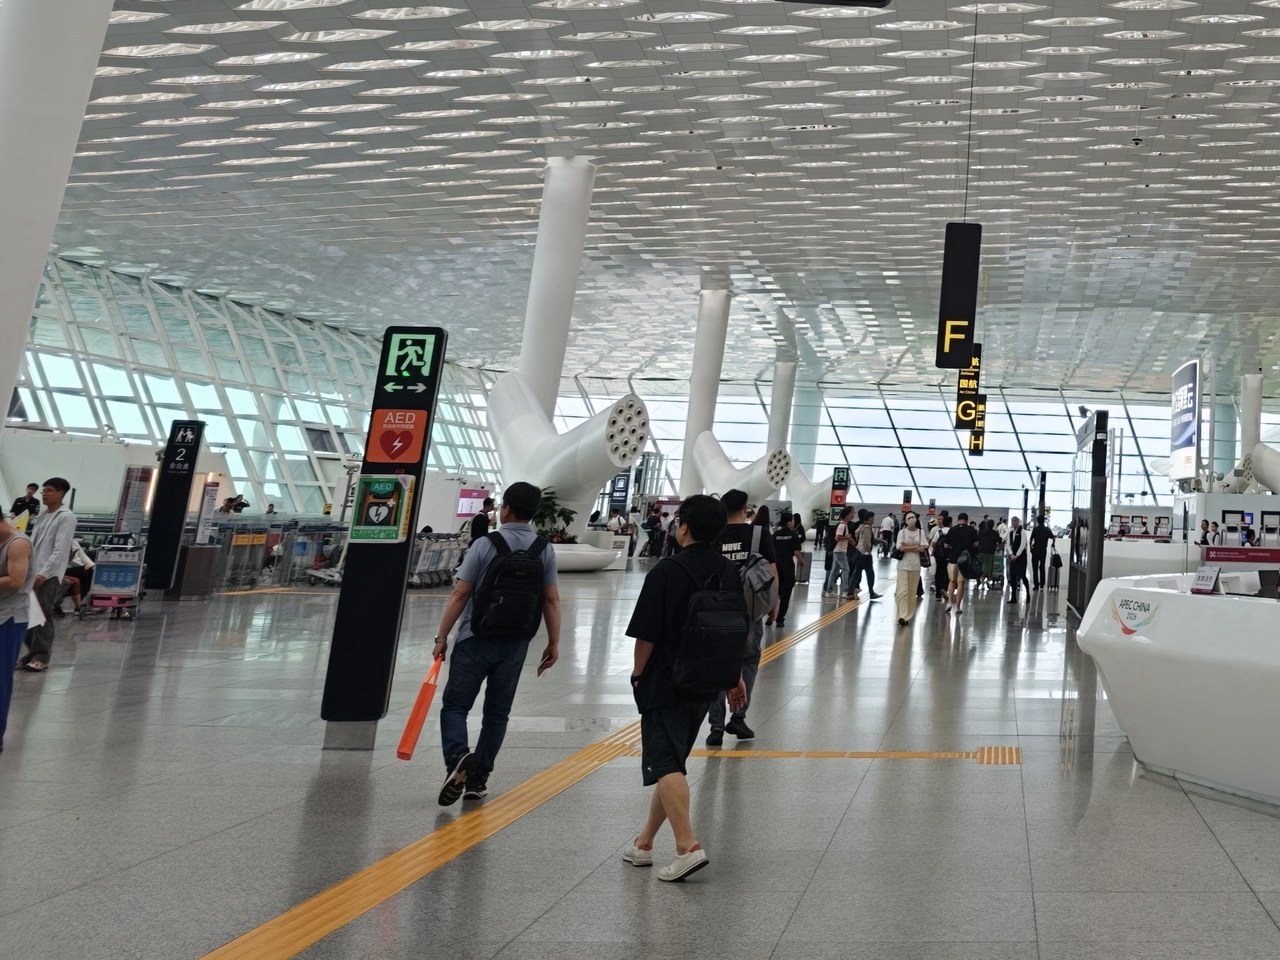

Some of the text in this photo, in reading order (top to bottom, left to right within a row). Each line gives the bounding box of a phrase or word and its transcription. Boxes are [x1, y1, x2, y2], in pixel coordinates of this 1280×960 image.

[943, 320, 969, 353] F
[959, 379, 977, 388] 国航
[957, 401, 976, 421] G
[384, 412, 416, 424] AED
[970, 435, 983, 450] H
[175, 448, 186, 461] 2
[373, 483, 392, 491] AED
[722, 542, 742, 551] MOVE
[1119, 598, 1151, 613] APEC CHINA
